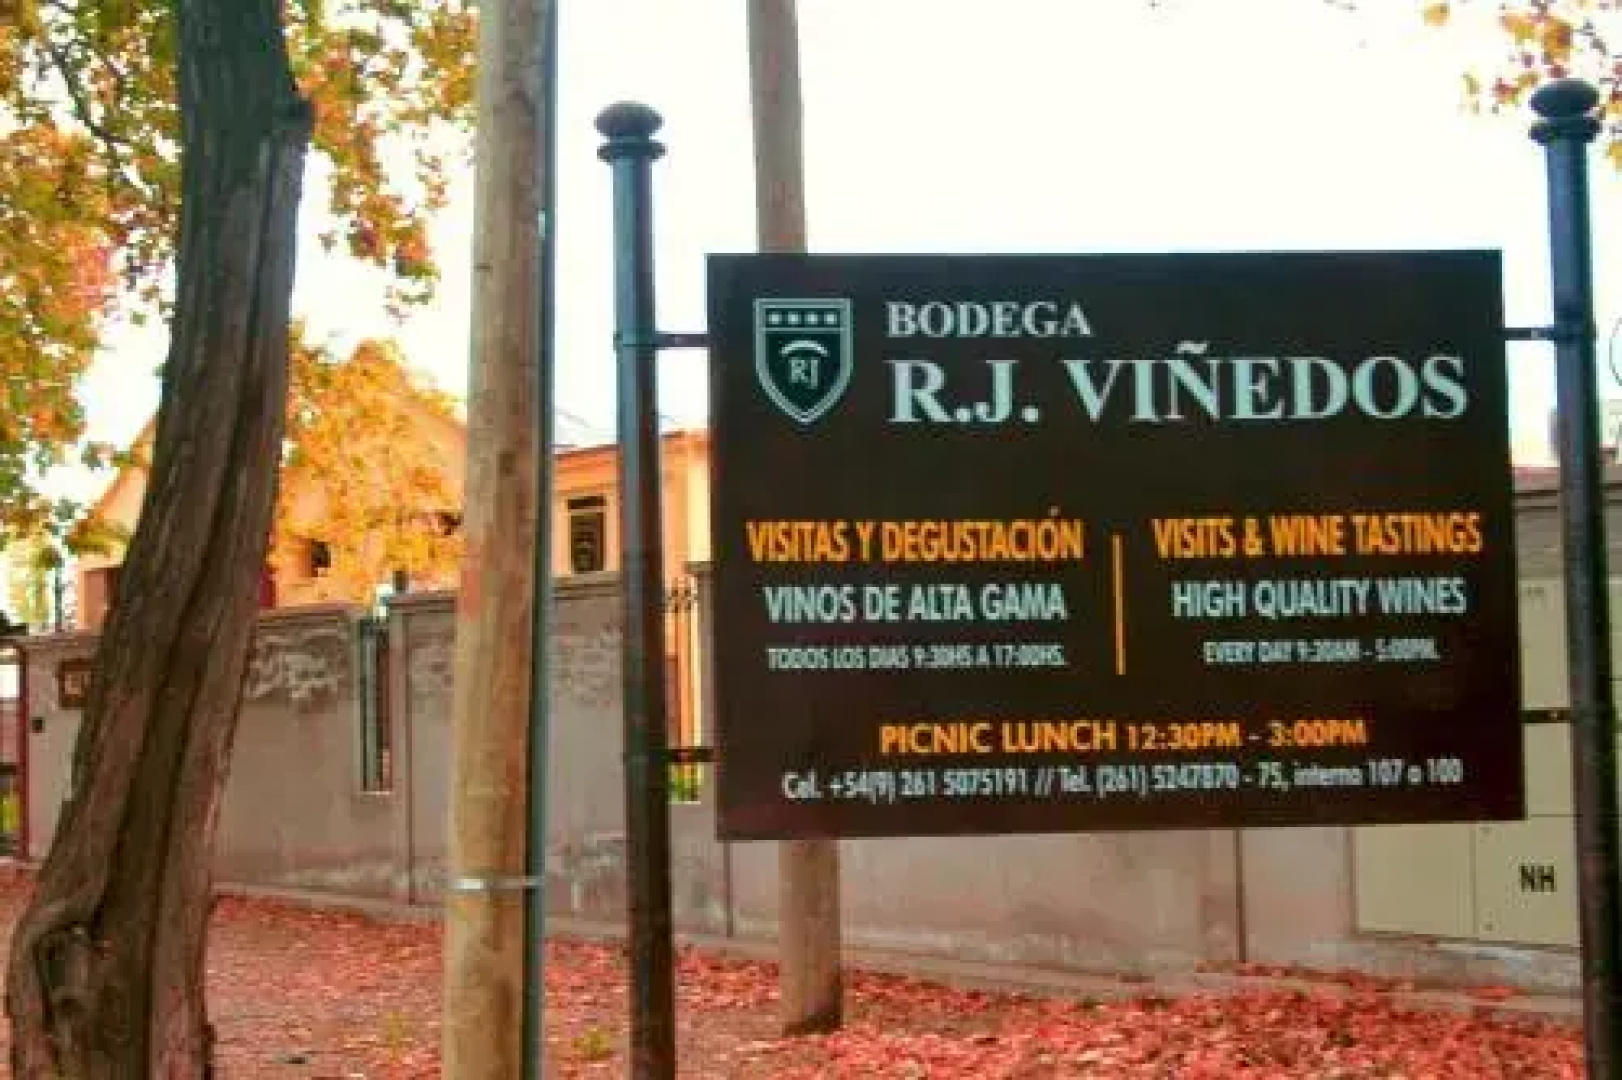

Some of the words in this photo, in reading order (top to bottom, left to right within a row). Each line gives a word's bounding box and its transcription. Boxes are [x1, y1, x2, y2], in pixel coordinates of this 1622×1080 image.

[887, 302, 1093, 338] BODEGA
[888, 358, 1039, 423] R.J.
[1063, 341, 1468, 422] VIÑEDOS
[747, 519, 848, 561] VISITAS
[856, 520, 874, 561] Y
[881, 507, 1083, 560] DEGUSTACIÓN
[1152, 518, 1234, 558] VISITS
[1244, 518, 1263, 556] &
[1271, 515, 1346, 555] WINE
[1352, 512, 1482, 553] TASTINGS
[764, 586, 855, 623] VINOS
[863, 585, 901, 621] DE
[908, 585, 974, 620] ALTA
[980, 583, 1067, 620] GAMA
[1172, 581, 1246, 617] HIGH
[1254, 578, 1370, 619] QUALITY
[1376, 576, 1467, 614] WINES
[767, 647, 829, 669] TODOS
[833, 647, 864, 668] LOS
[1203, 641, 1256, 663] EVERY
[1259, 641, 1293, 662] DAY
[879, 723, 993, 753] PICNIC
[1002, 721, 1117, 752] LUNCH
[1127, 722, 1242, 750] 12:30PM
[1269, 719, 1367, 747] 3:00PM
[900, 770, 935, 796] 261
[1520, 865, 1556, 893] NH
